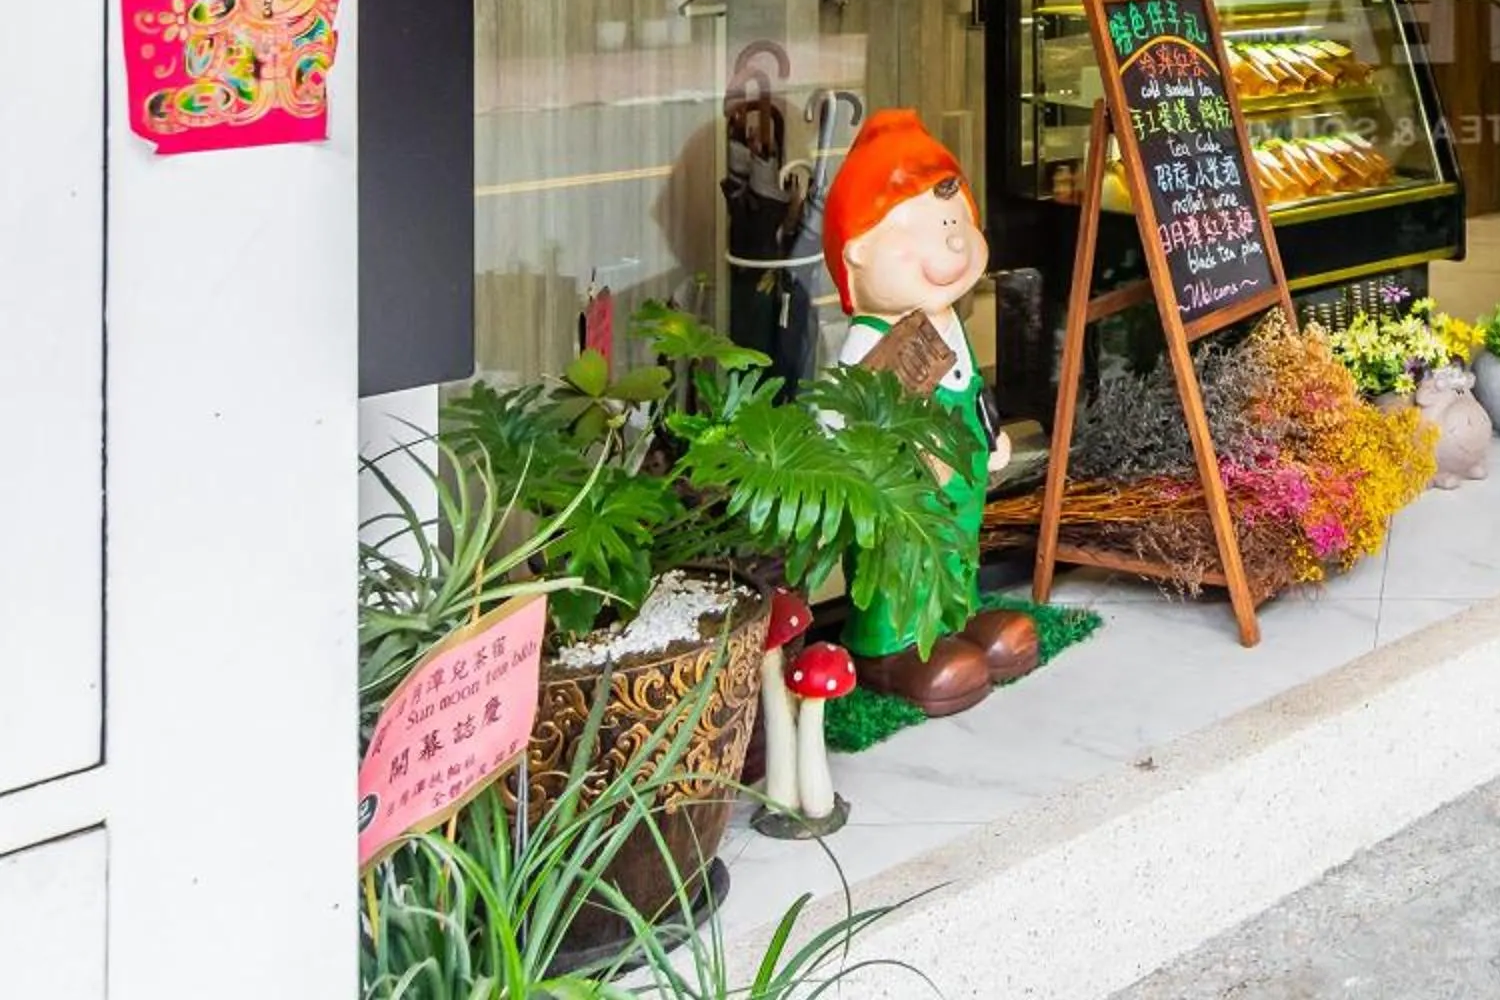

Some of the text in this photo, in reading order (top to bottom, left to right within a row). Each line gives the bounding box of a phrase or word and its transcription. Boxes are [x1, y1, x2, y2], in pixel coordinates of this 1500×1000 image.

[1167, 135, 1193, 157] tea
[404, 703, 435, 731] Sun
[439, 679, 480, 712] moon
